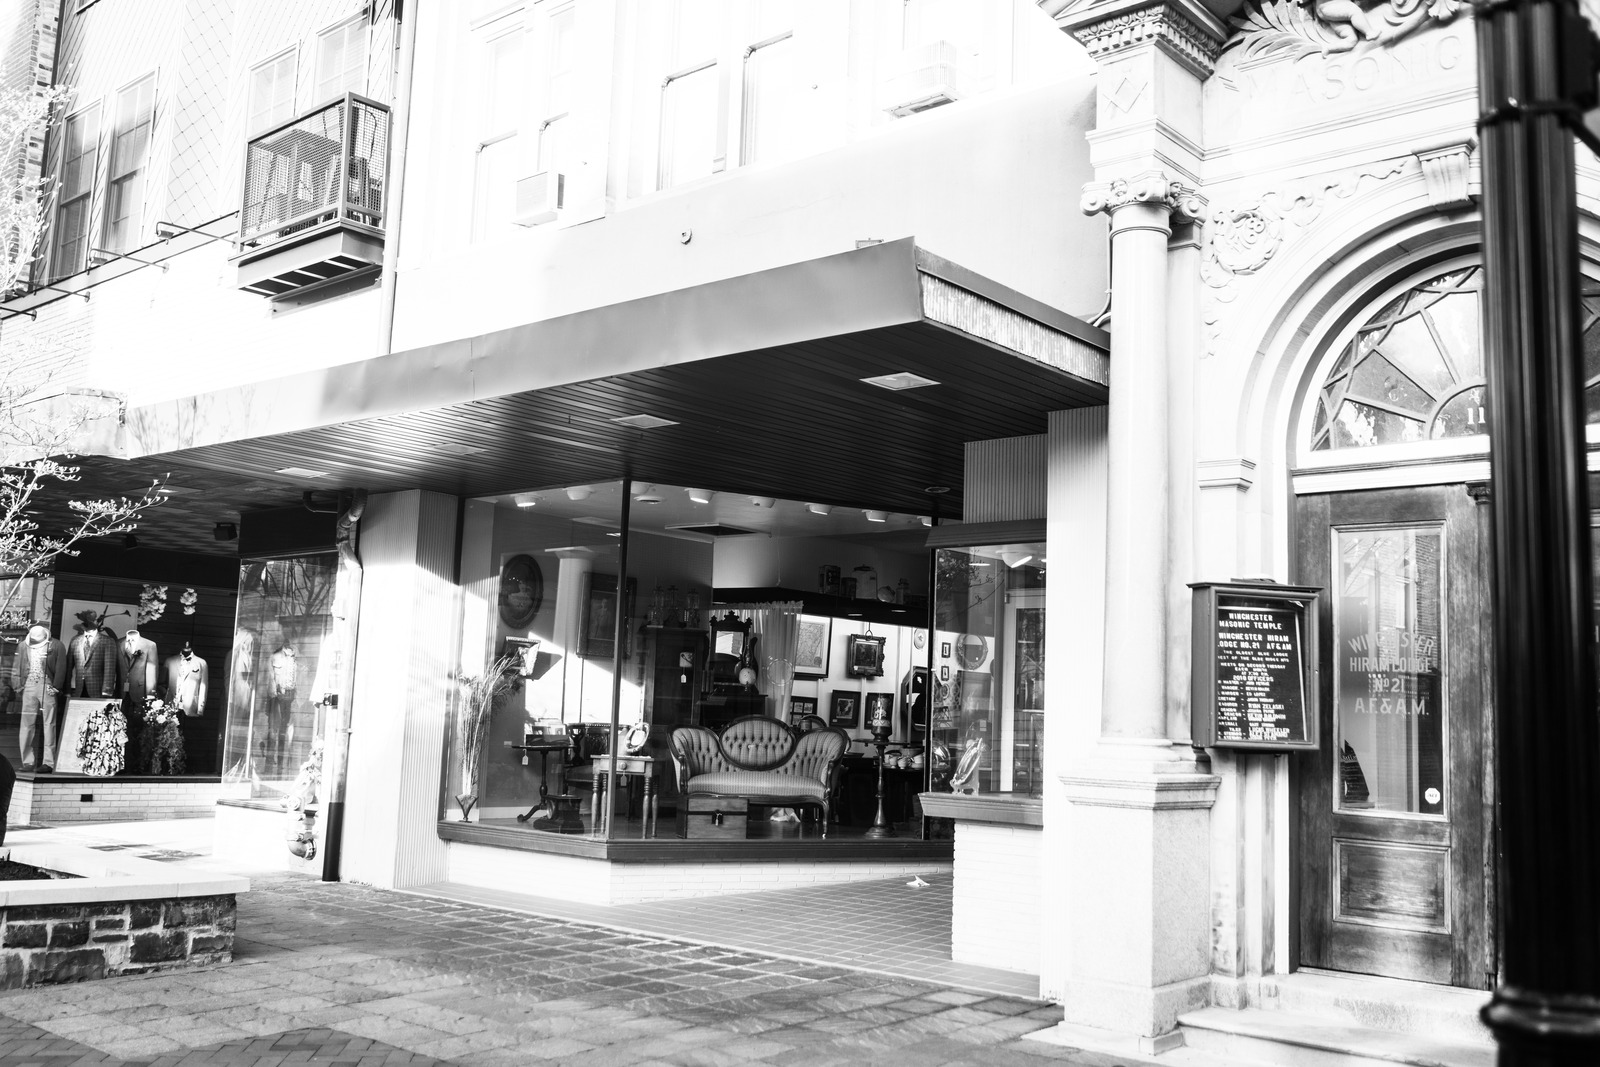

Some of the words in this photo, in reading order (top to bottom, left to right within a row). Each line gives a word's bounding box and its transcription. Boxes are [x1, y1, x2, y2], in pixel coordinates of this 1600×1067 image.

[1246, 34, 1462, 105] MASONIC
[1228, 613, 1273, 621] WINCHESTER
[1219, 620, 1250, 628] MASONIC
[1253, 621, 1282, 630] TEMPLE
[1218, 632, 1263, 641] WINCHESTER
[1267, 634, 1289, 642] HIRAM
[1218, 640, 1238, 648] ODGE
[1348, 631, 1434, 656] WICSTER
[1349, 657, 1390, 672] HIRAM
[1391, 657, 1433, 673] LODGE
[1390, 678, 1405, 693] 21
